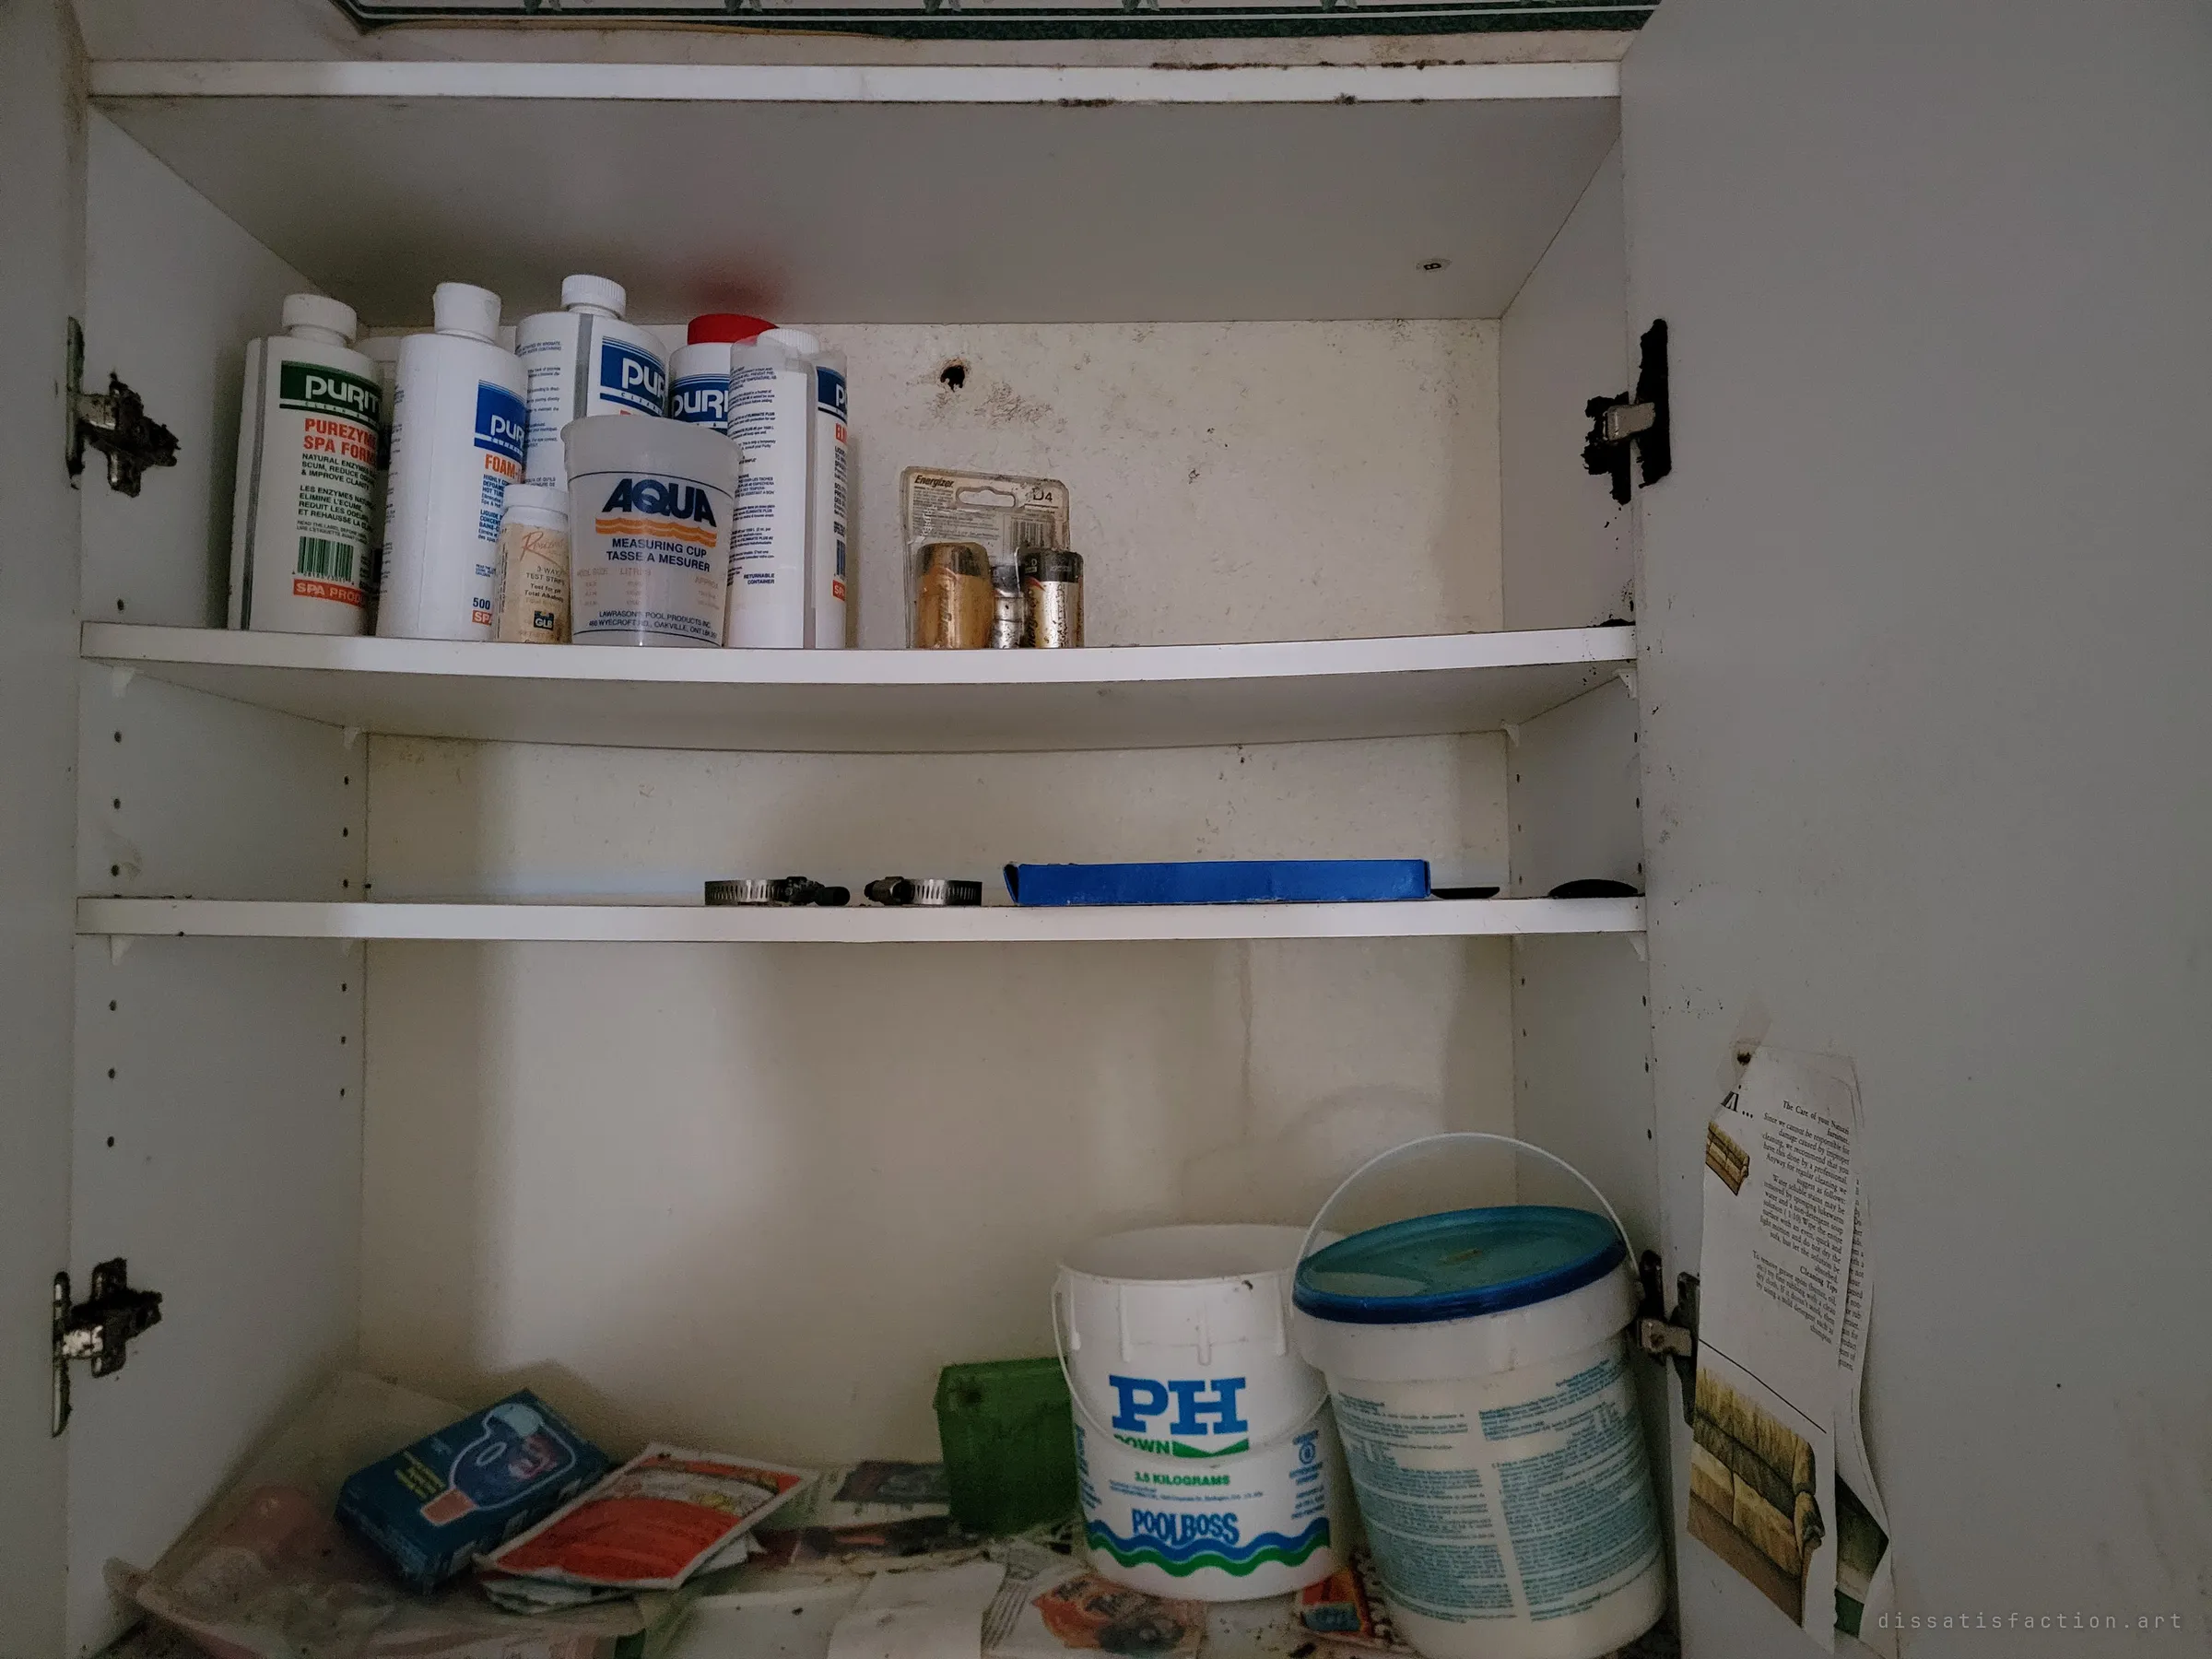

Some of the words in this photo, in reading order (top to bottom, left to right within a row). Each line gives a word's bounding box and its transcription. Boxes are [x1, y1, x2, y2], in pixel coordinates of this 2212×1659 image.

[303, 435, 335, 453] SPA
[302, 453, 339, 465] NATURAL
[309, 470, 345, 482] IMPROVE
[329, 465, 359, 478] REDUCE
[914, 475, 955, 488] Energizer
[300, 485, 316, 493] LES
[317, 487, 354, 501] ENZYMES
[298, 500, 328, 512] REDUIT
[329, 506, 346, 514] LES
[602, 477, 717, 528] AQUA
[298, 509, 308, 517] ET
[310, 511, 352, 524] REHAUSSE
[612, 537, 683, 553] MEASURING
[686, 546, 707, 559] CUP
[606, 550, 644, 562] TASSE
[647, 552, 655, 562] A
[658, 555, 711, 572] MESURER
[743, 572, 775, 581] RETURNABLE
[296, 582, 325, 595] SPA
[473, 597, 490, 610] 500
[644, 612, 665, 620] POOL
[666, 614, 701, 626] PRODUCTS
[1109, 1374, 1249, 1435] PH
[1153, 1474, 1230, 1486] KILOGRAMS
[1132, 1509, 1240, 1546] POOLBOSS
